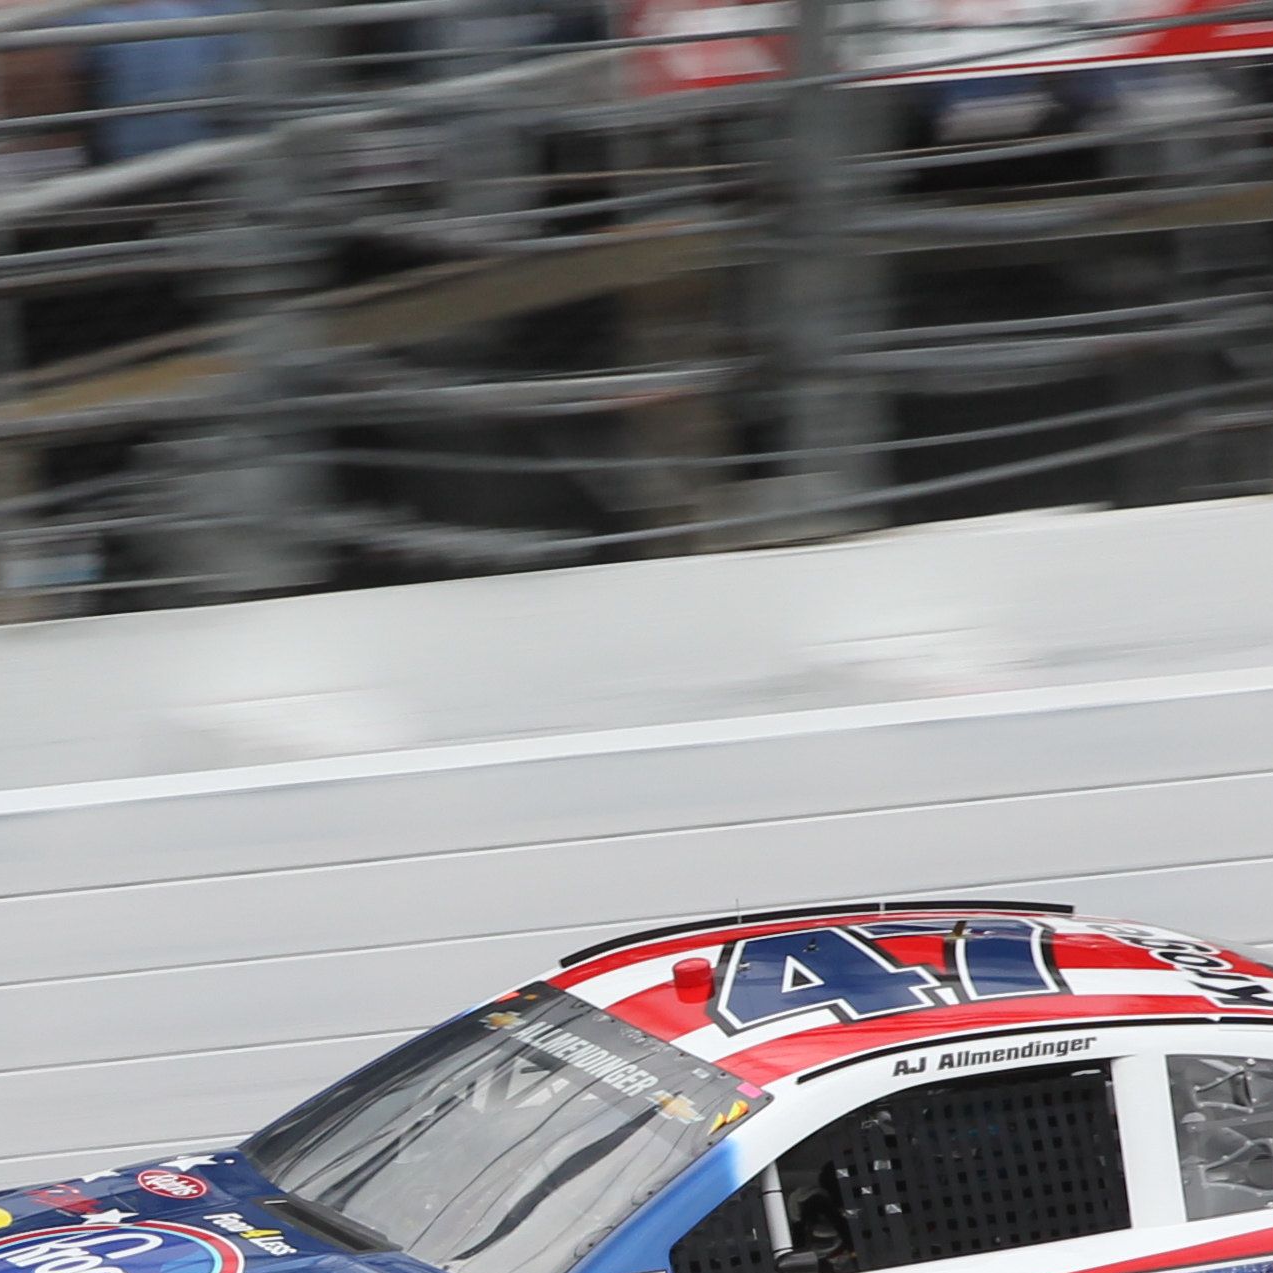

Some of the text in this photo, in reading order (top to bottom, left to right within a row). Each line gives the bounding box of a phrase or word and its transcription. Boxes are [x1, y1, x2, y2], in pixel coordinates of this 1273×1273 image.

[511, 1020, 659, 1097] ALLMENDINGER
[892, 1036, 1098, 1077] AJ Allmendinger
